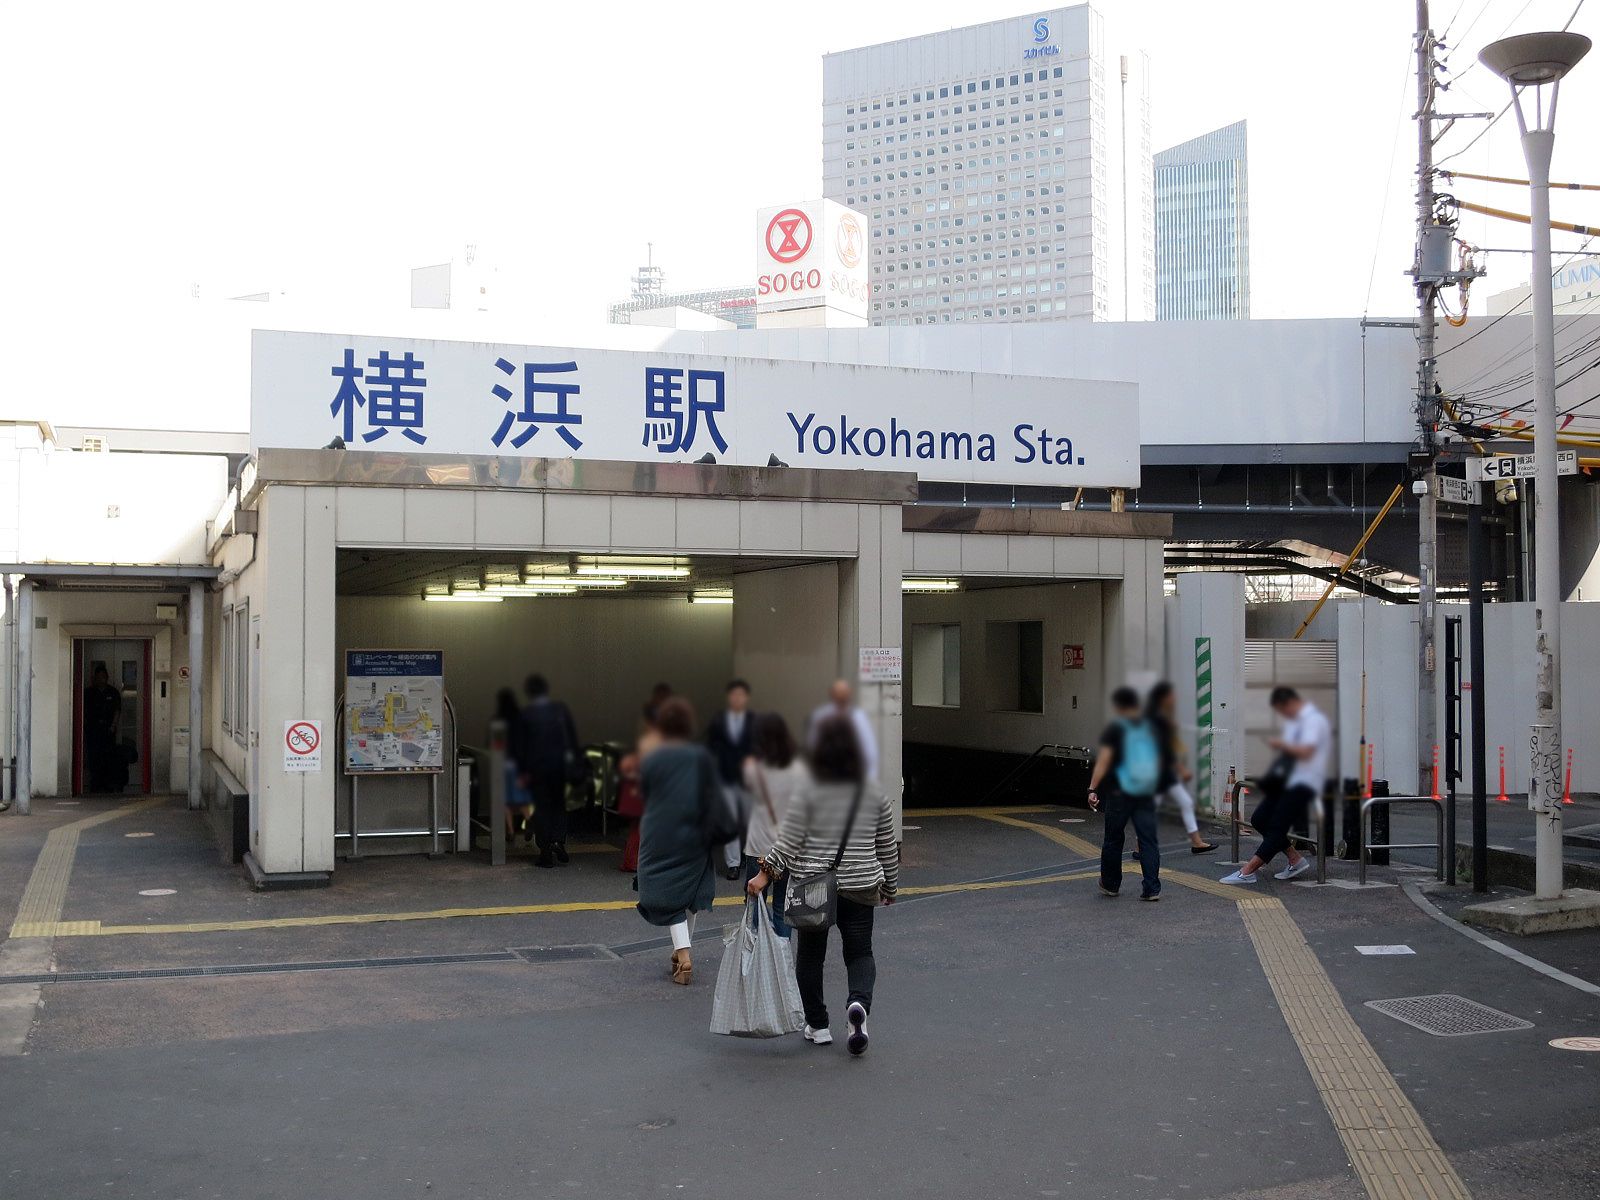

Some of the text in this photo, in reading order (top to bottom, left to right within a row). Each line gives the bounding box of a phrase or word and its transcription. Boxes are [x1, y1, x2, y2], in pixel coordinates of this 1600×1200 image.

[758, 269, 821, 295] SOGO
[331, 348, 728, 455] 横浜駅
[787, 411, 1086, 465] Yokohama Sta.
